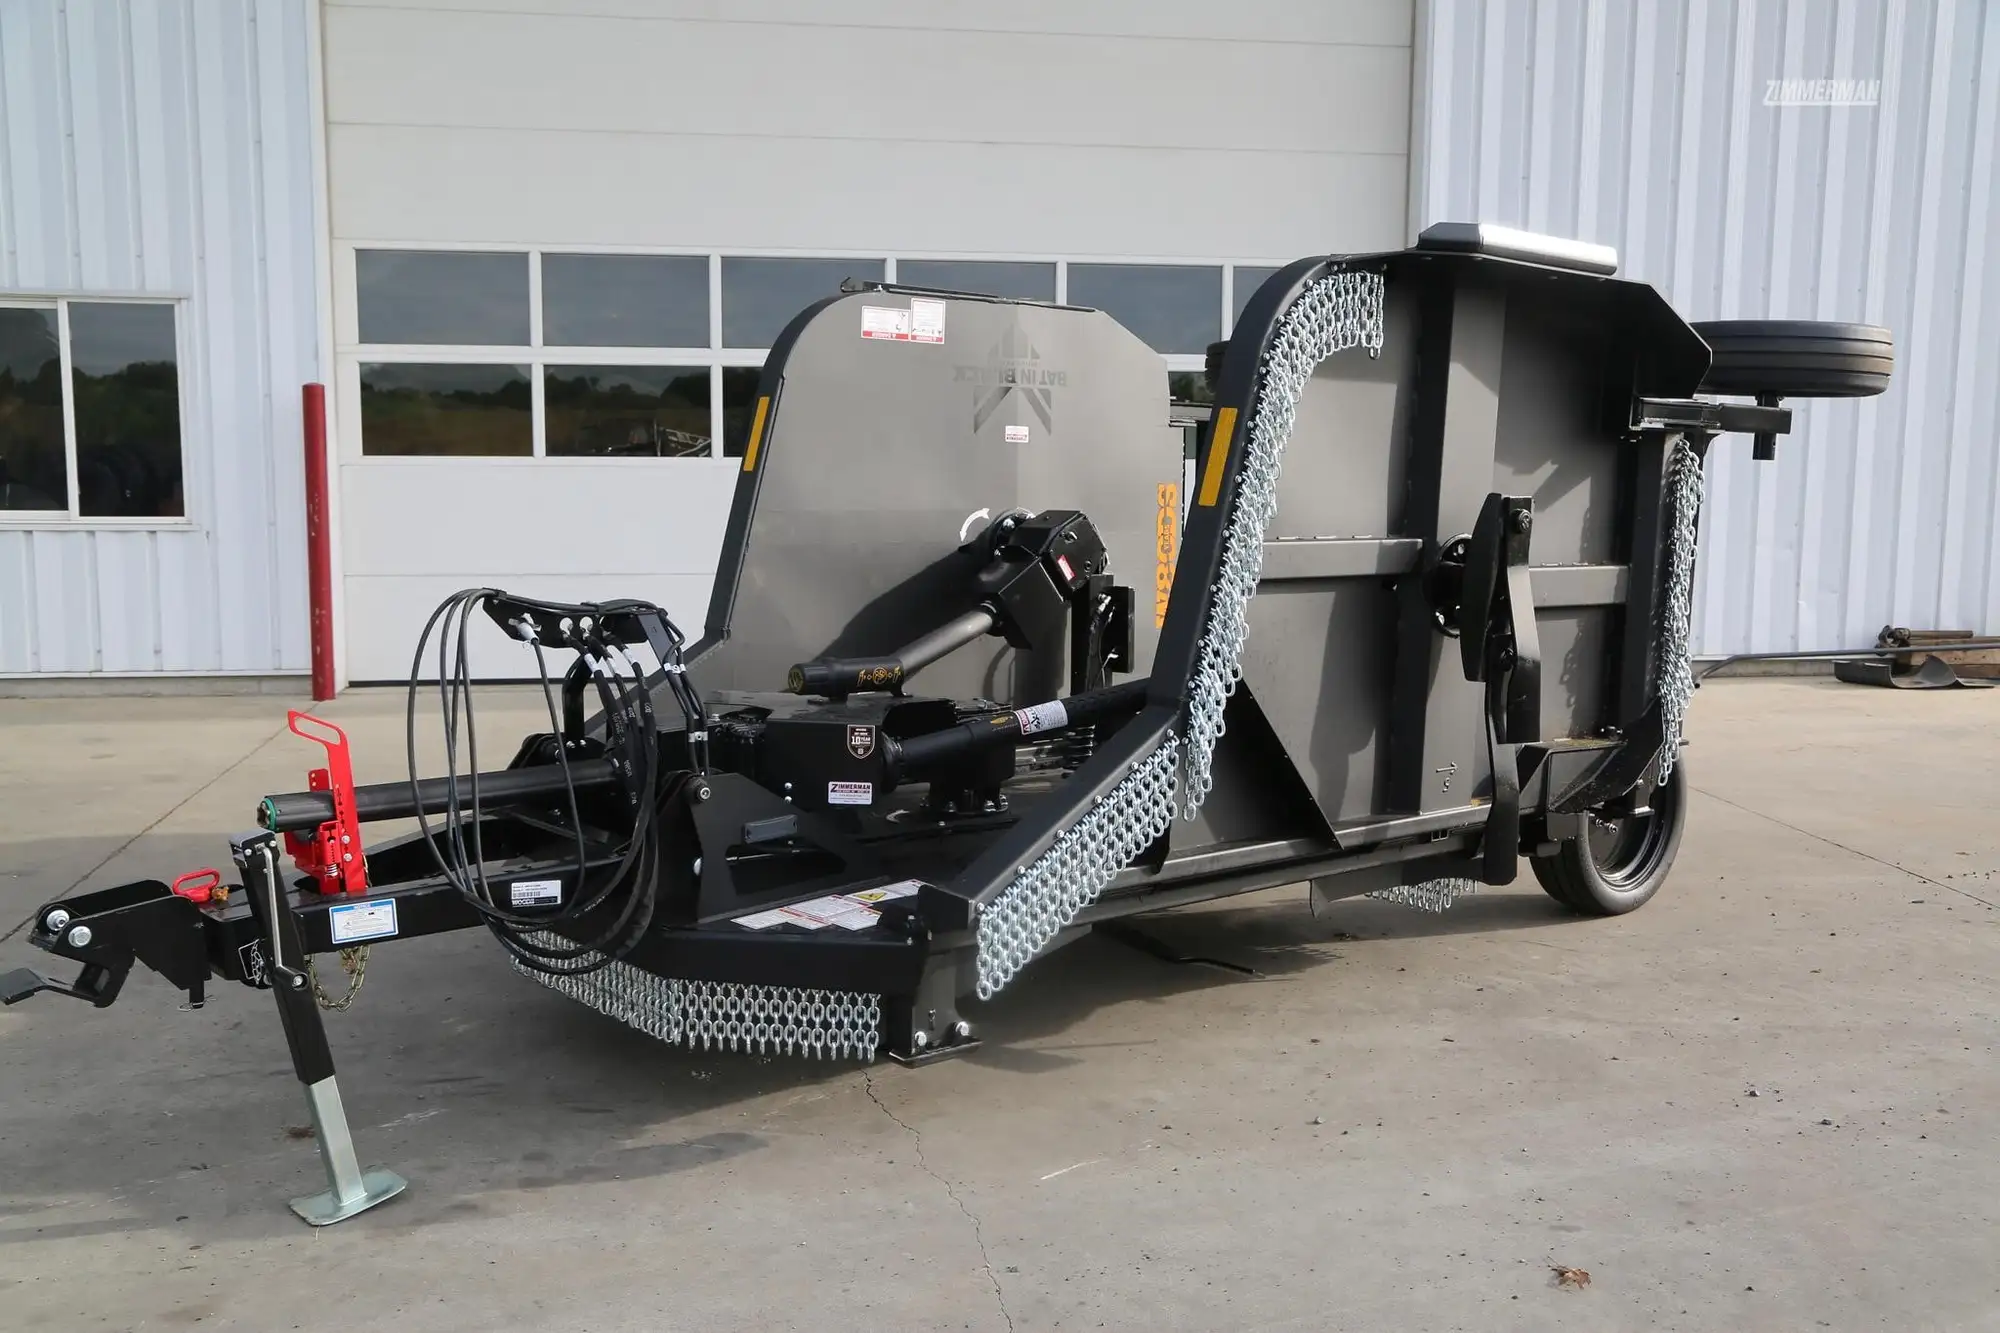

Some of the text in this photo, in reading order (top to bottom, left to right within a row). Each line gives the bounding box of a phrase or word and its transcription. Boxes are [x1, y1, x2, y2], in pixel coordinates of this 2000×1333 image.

[1020, 368, 1036, 386] IN
[1039, 370, 1068, 387] BAT
[851, 736, 860, 744] 10
[830, 783, 871, 793] ZIMMERMAN
